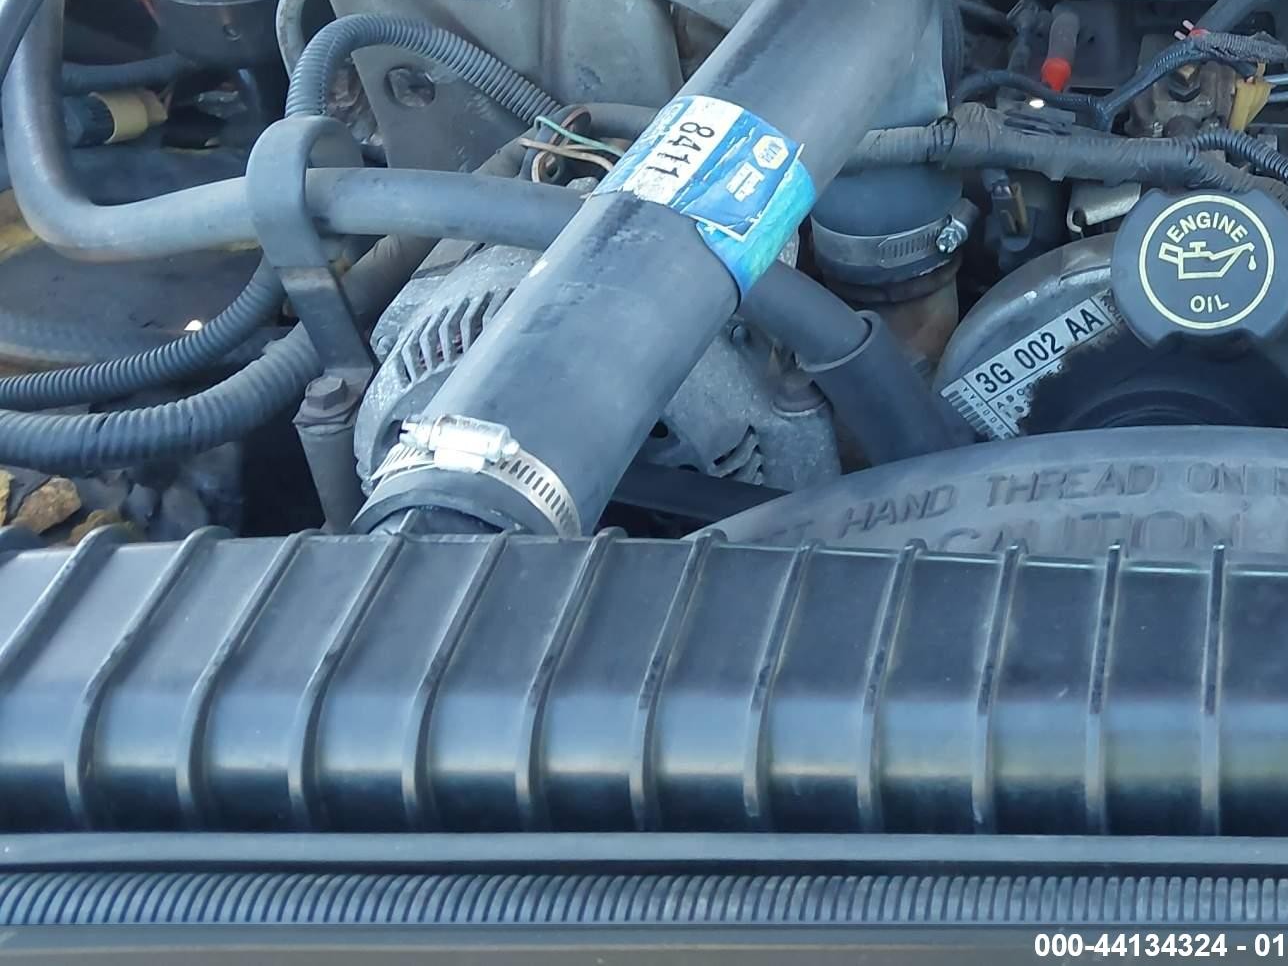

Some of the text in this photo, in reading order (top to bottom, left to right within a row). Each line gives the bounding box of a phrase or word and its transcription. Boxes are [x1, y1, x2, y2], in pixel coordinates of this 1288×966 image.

[646, 121, 716, 179] 8411
[1166, 211, 1249, 243] ENGINE
[1189, 294, 1230, 313] OIL
[975, 362, 1015, 393] 3G
[1013, 331, 1065, 370] 002
[1064, 307, 1105, 342] AA
[839, 483, 957, 536] HAND
[986, 463, 1160, 508] THREAD
[1184, 463, 1247, 497] ON
